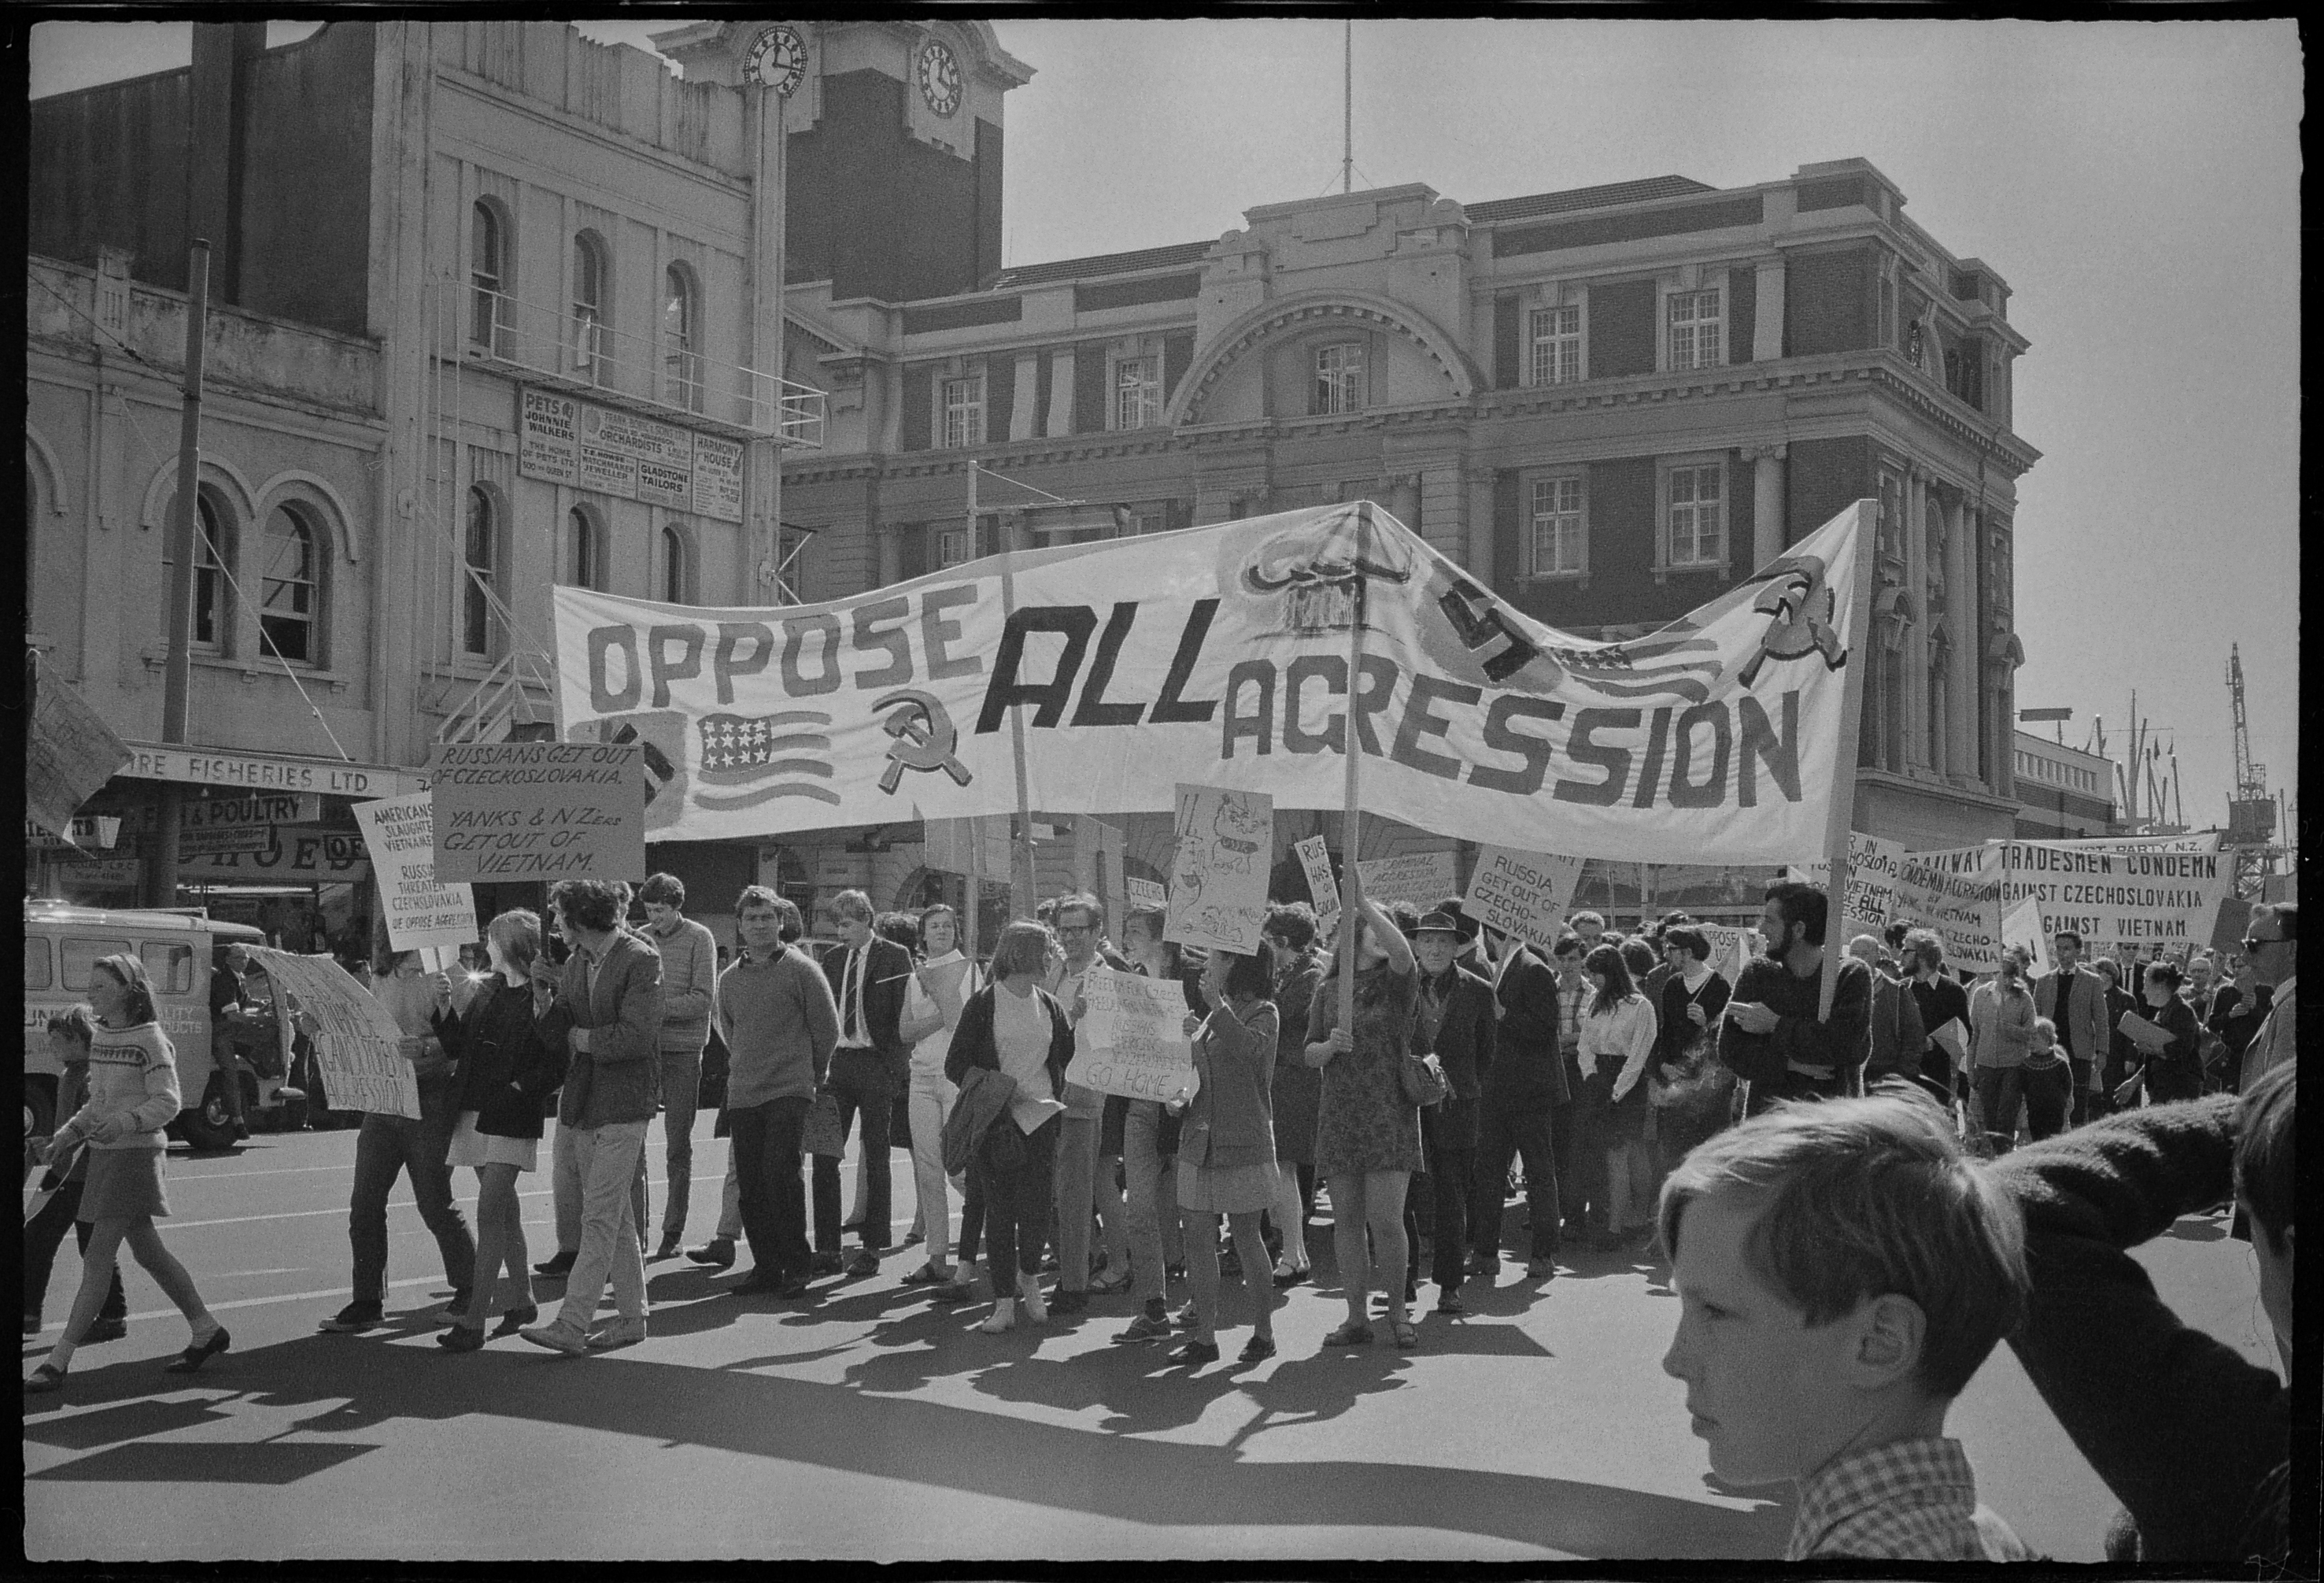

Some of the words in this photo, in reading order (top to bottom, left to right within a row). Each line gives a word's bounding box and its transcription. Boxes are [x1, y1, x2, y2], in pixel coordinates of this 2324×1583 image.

[526, 393, 560, 414] PETS
[525, 411, 571, 429] JOHNNIE
[529, 422, 575, 441] WALKERS
[600, 429, 663, 454] ORCHARDISTS
[530, 441, 546, 452] THE
[549, 445, 571, 457] HOME
[697, 437, 738, 457] HARMONY
[582, 456, 635, 472] WATCHMAKER
[704, 452, 732, 469] HOUSE
[583, 464, 628, 479] JEWELLER
[641, 464, 688, 483] GLADSTONE
[641, 475, 683, 493] TAILORS
[587, 584, 985, 713] OPPOSE
[974, 598, 1221, 734] ALL
[441, 746, 546, 765] RUSSIANS
[547, 745, 587, 764] GET
[592, 746, 639, 766] OUT
[190, 757, 313, 787] FISHERIES
[331, 771, 368, 792] LTD
[430, 768, 454, 785] OF
[210, 796, 300, 825] POULTRY
[449, 810, 523, 827] YANKS
[529, 808, 545, 827] &
[385, 820, 433, 839] SLAUGHTE
[382, 834, 433, 853] VIETNAME
[443, 832, 499, 851] GET
[495, 832, 545, 850] OUT
[549, 830, 588, 849] OF
[2175, 842, 2203, 853] N.Z.
[476, 852, 593, 874] VIETNAM.
[2000, 845, 2112, 874] TRADESMEN
[2126, 855, 2217, 879] CONDEMN
[1495, 854, 1553, 894] RUSSIA
[1901, 863, 1945, 893] ONDEMN
[1481, 871, 1512, 893] GET
[1511, 884, 1541, 906] OUT
[1541, 898, 1561, 913] OF
[2002, 882, 2058, 903] GAINST
[2064, 884, 2203, 908] CZECHOSLOVAKIA
[1474, 886, 1538, 920] CZECHO-
[1858, 894, 1885, 914] ALL
[405, 914, 432, 929] OPPOSE
[1485, 908, 1553, 950] SLOVAKIA
[2044, 914, 2101, 935] GAINST
[2118, 917, 2189, 938] VIETNAM.
[1086, 1062, 1113, 1087] GO
[1123, 1067, 1172, 1097] HOME
